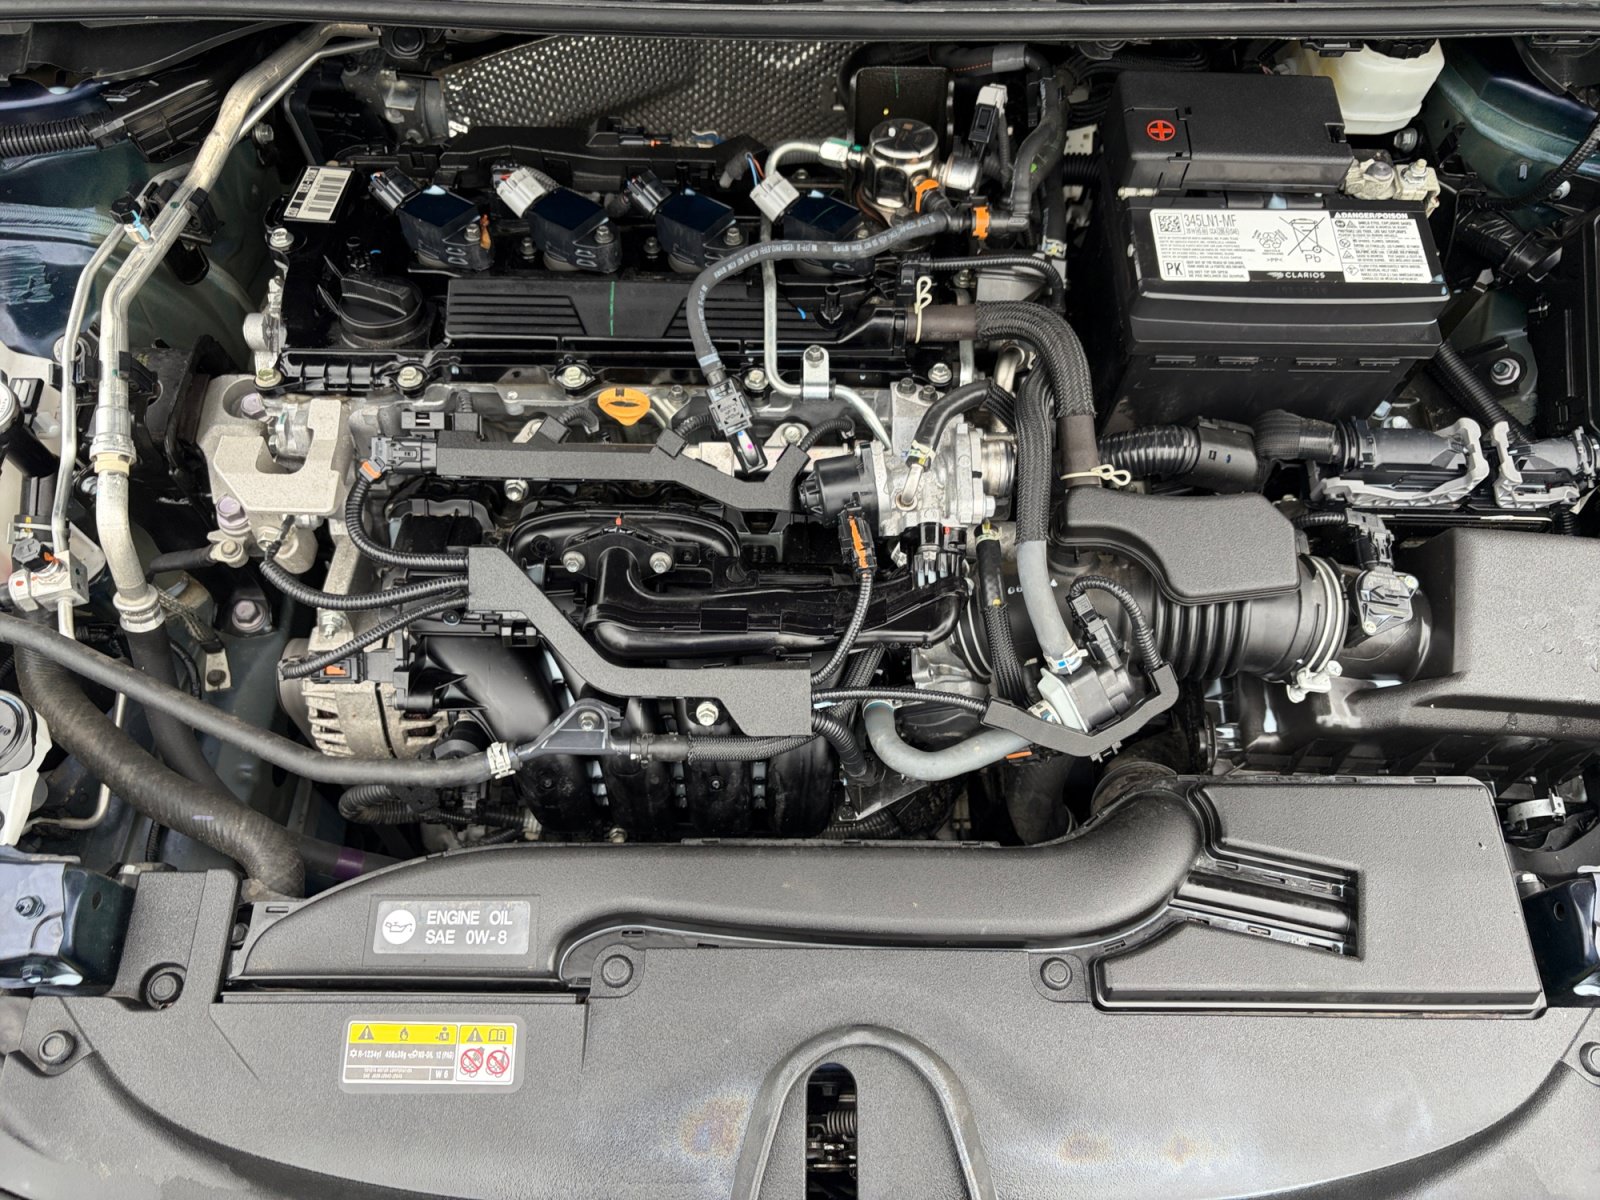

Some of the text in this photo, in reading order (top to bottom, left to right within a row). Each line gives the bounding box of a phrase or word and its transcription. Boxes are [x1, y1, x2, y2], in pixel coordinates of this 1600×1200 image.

[1184, 214, 1237, 227] 345LN1-MF
[1304, 254, 1322, 263] Pb
[1166, 262, 1183, 275] PK
[426, 910, 513, 925] ENGINE OIL
[425, 929, 508, 945] SAE 0W-8
